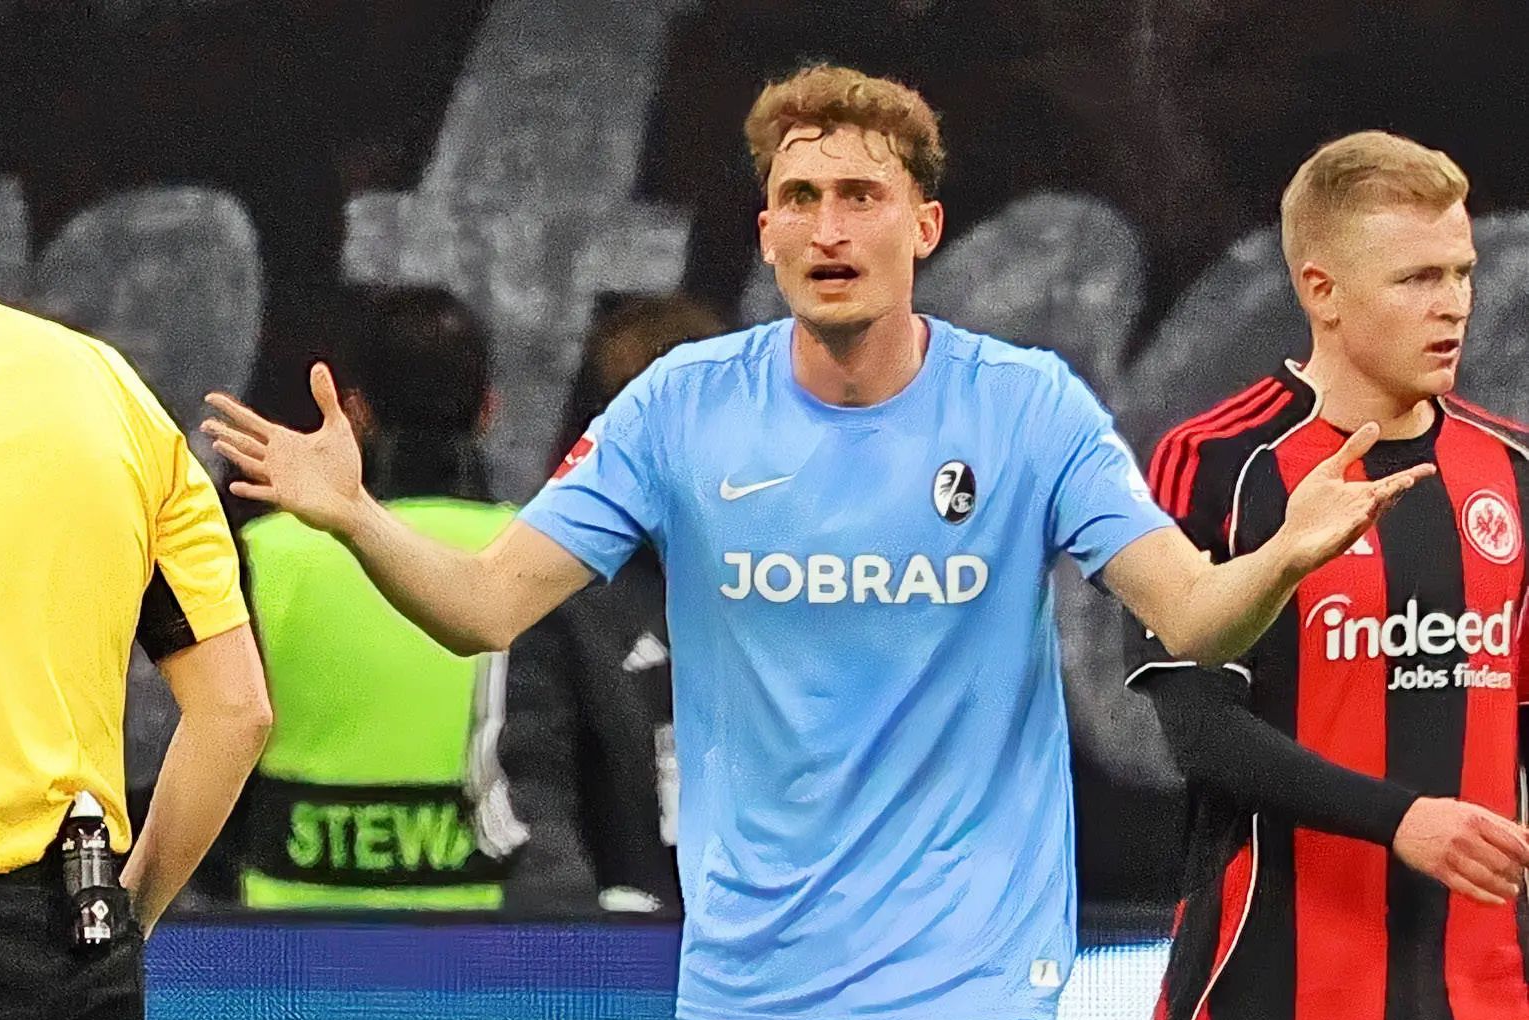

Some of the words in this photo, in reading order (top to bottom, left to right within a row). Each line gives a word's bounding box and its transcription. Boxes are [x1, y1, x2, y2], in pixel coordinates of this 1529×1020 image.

[720, 552, 988, 604] JOBRAD
[1313, 597, 1513, 661] indeed
[1387, 664, 1449, 690] Jobs
